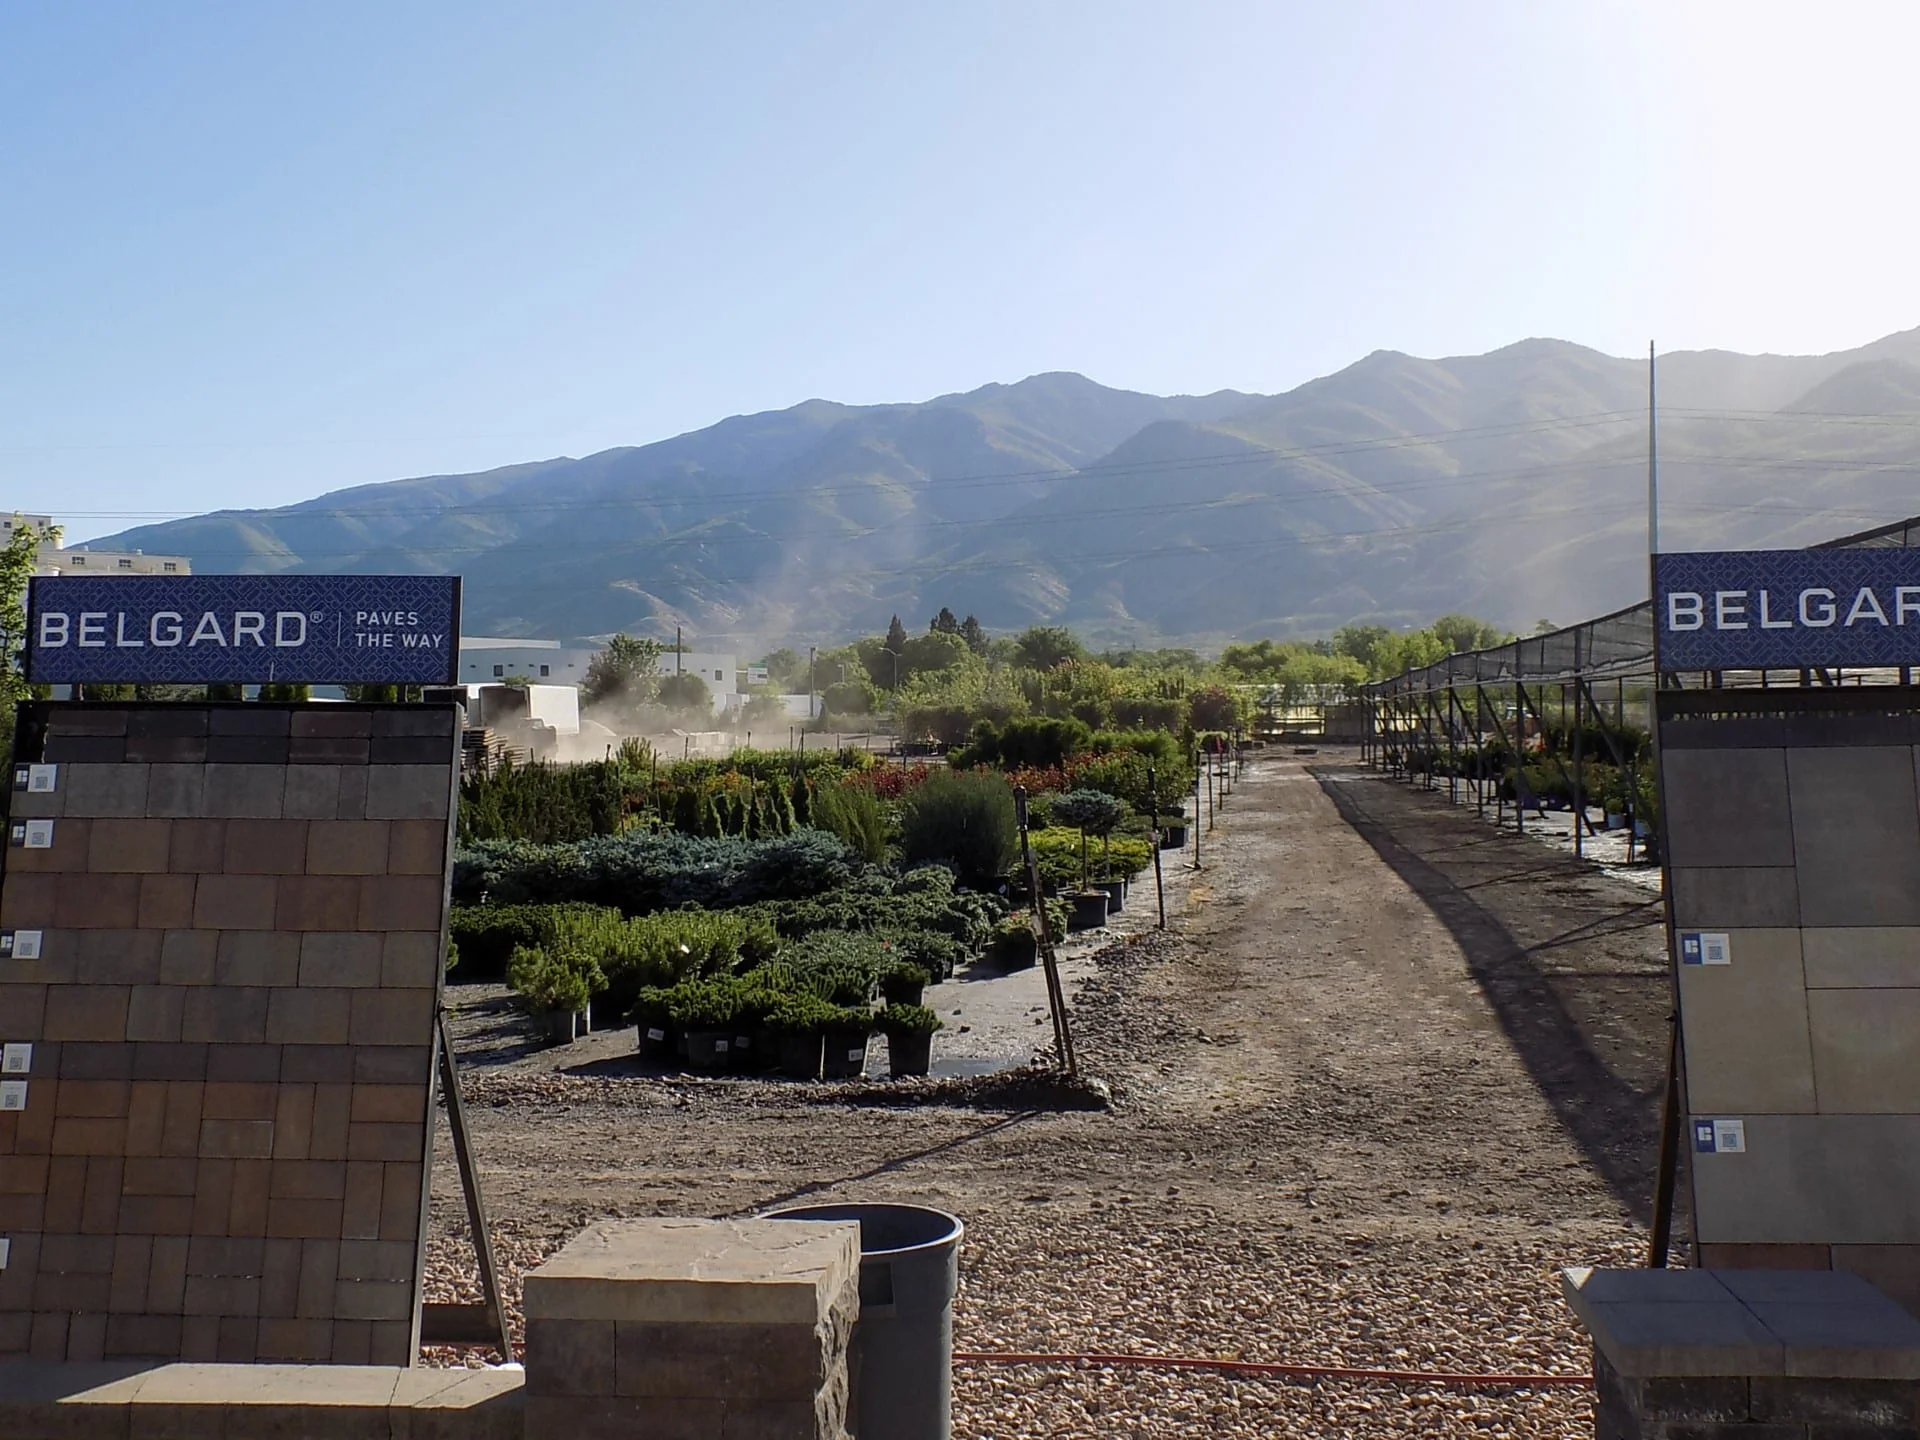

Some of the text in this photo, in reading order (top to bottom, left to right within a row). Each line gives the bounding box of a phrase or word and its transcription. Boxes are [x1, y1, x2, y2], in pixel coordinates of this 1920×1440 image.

[356, 611, 418, 626] PAVES
[356, 633, 443, 648] THE WAY
